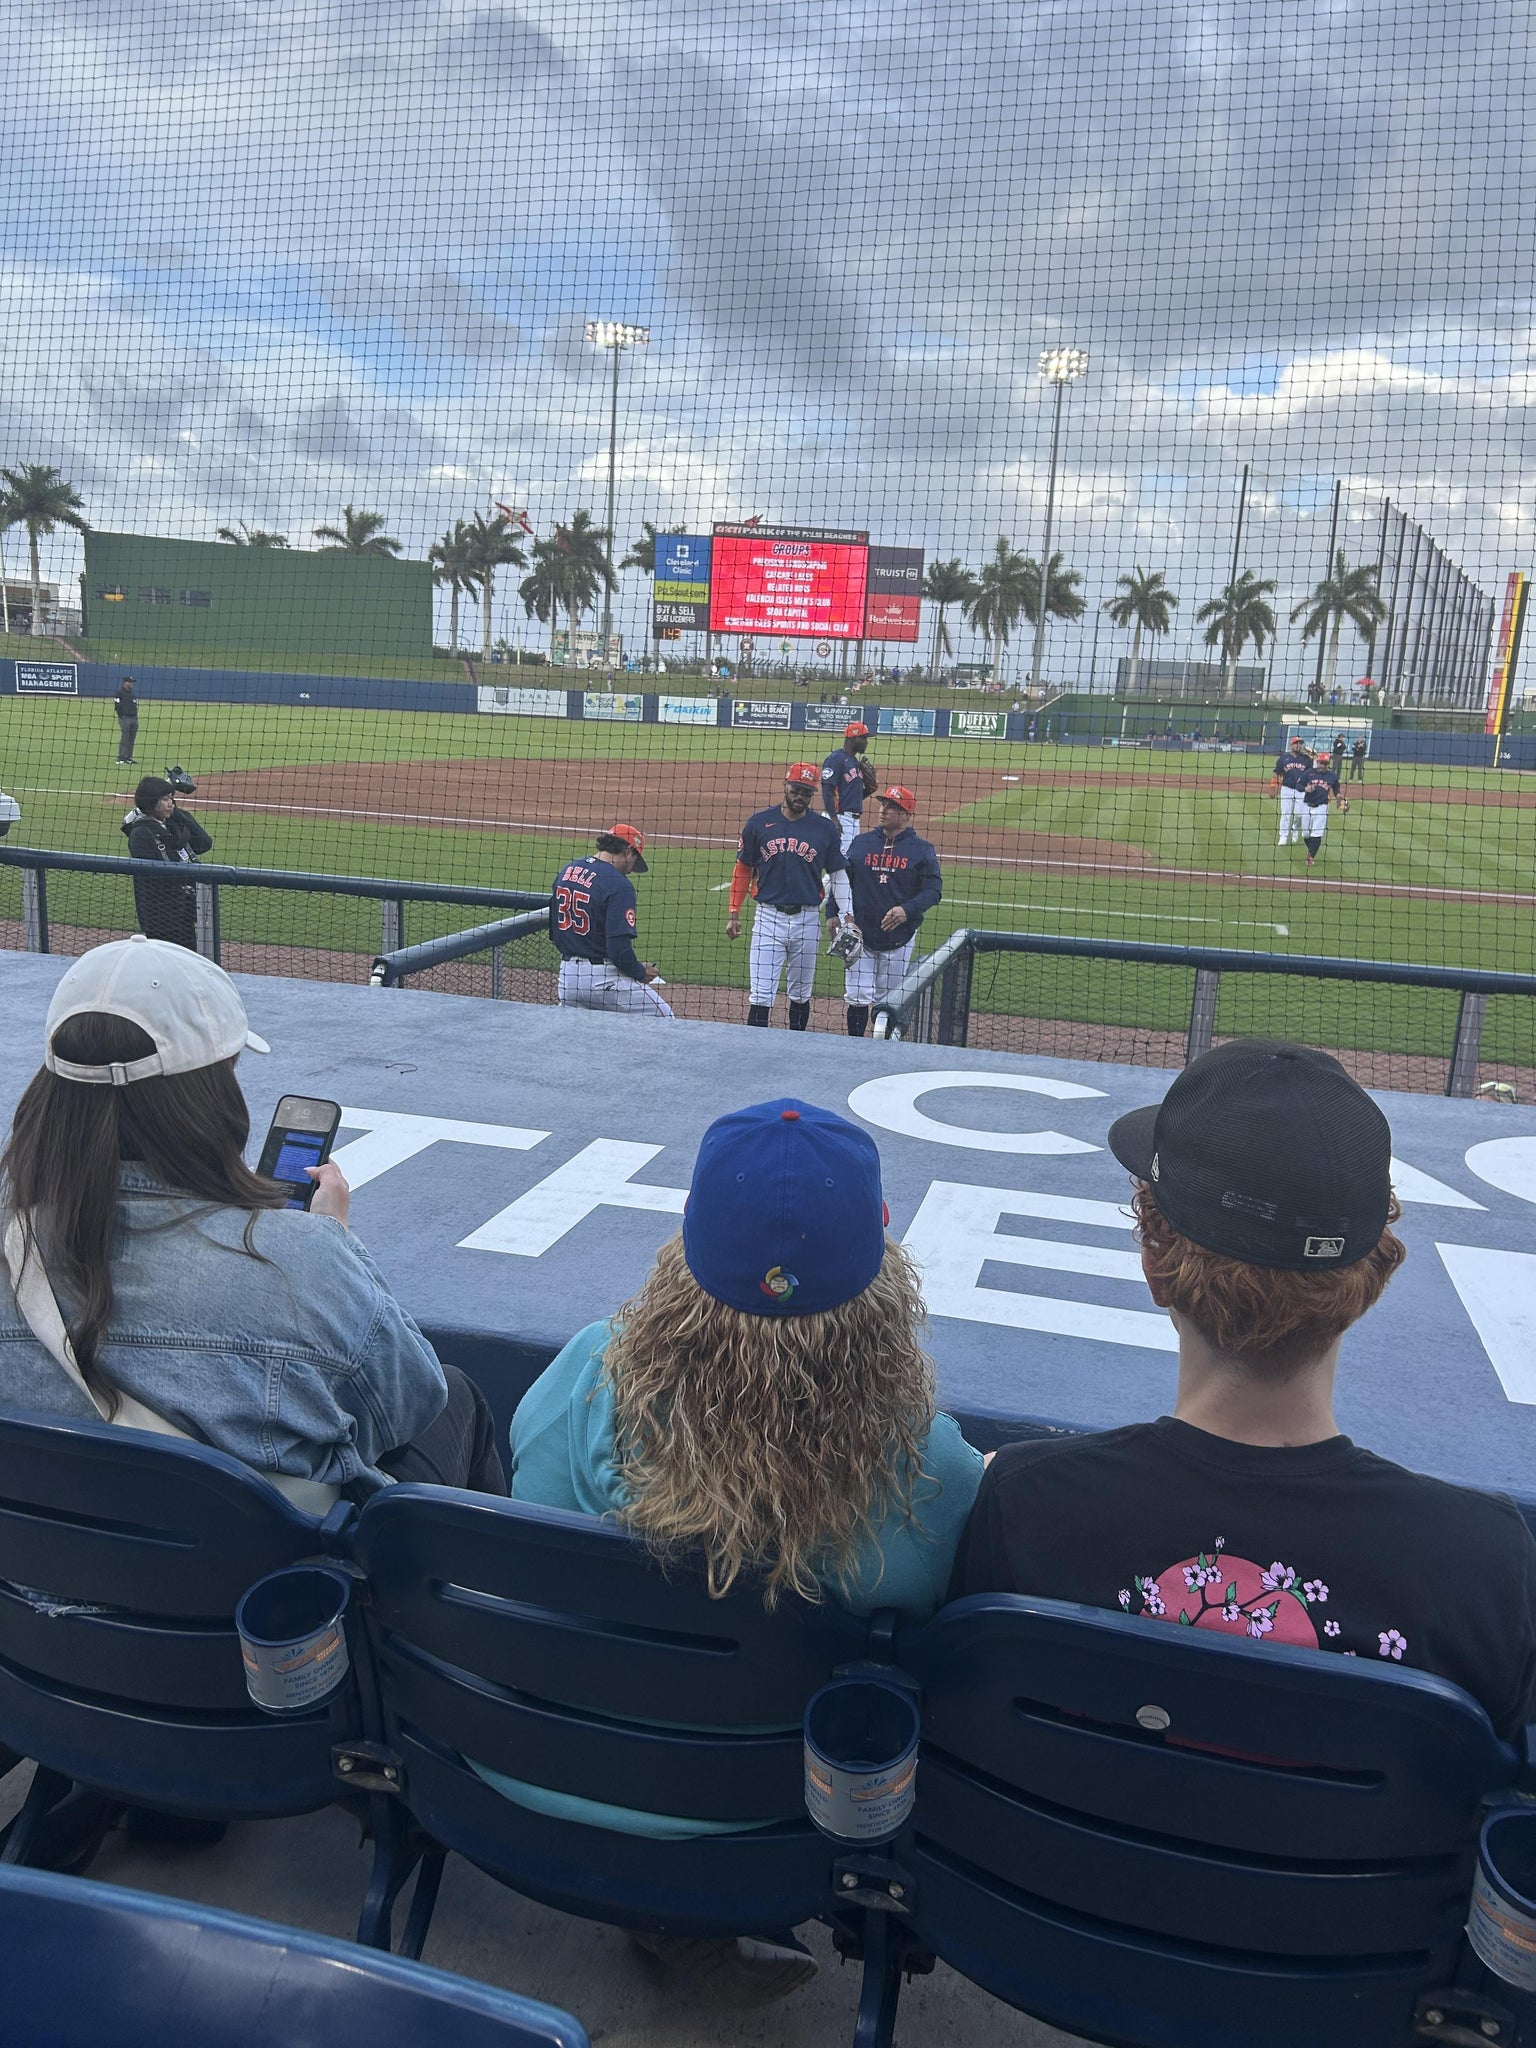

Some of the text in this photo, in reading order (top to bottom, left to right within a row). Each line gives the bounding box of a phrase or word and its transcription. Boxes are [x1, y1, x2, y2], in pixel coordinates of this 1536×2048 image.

[742, 527, 775, 535] PARK
[772, 543, 811, 556] GROUPS
[666, 558, 699, 566] Cleveland
[672, 567, 692, 575] Clinic
[875, 568, 905, 577] TRUIST
[656, 605, 696, 616] BUY & SELL
[22, 680, 72, 688] MANAGEMENT
[673, 703, 712, 715] DAIKIN
[751, 703, 789, 714] PALM BEACH
[814, 707, 858, 715] UNLIMITED
[760, 837, 818, 863] ASTROS
[864, 852, 909, 870] ASTROS
[562, 865, 597, 888] BELL
[556, 886, 590, 936] 35
[857, 1802, 887, 1814] FAMILY
